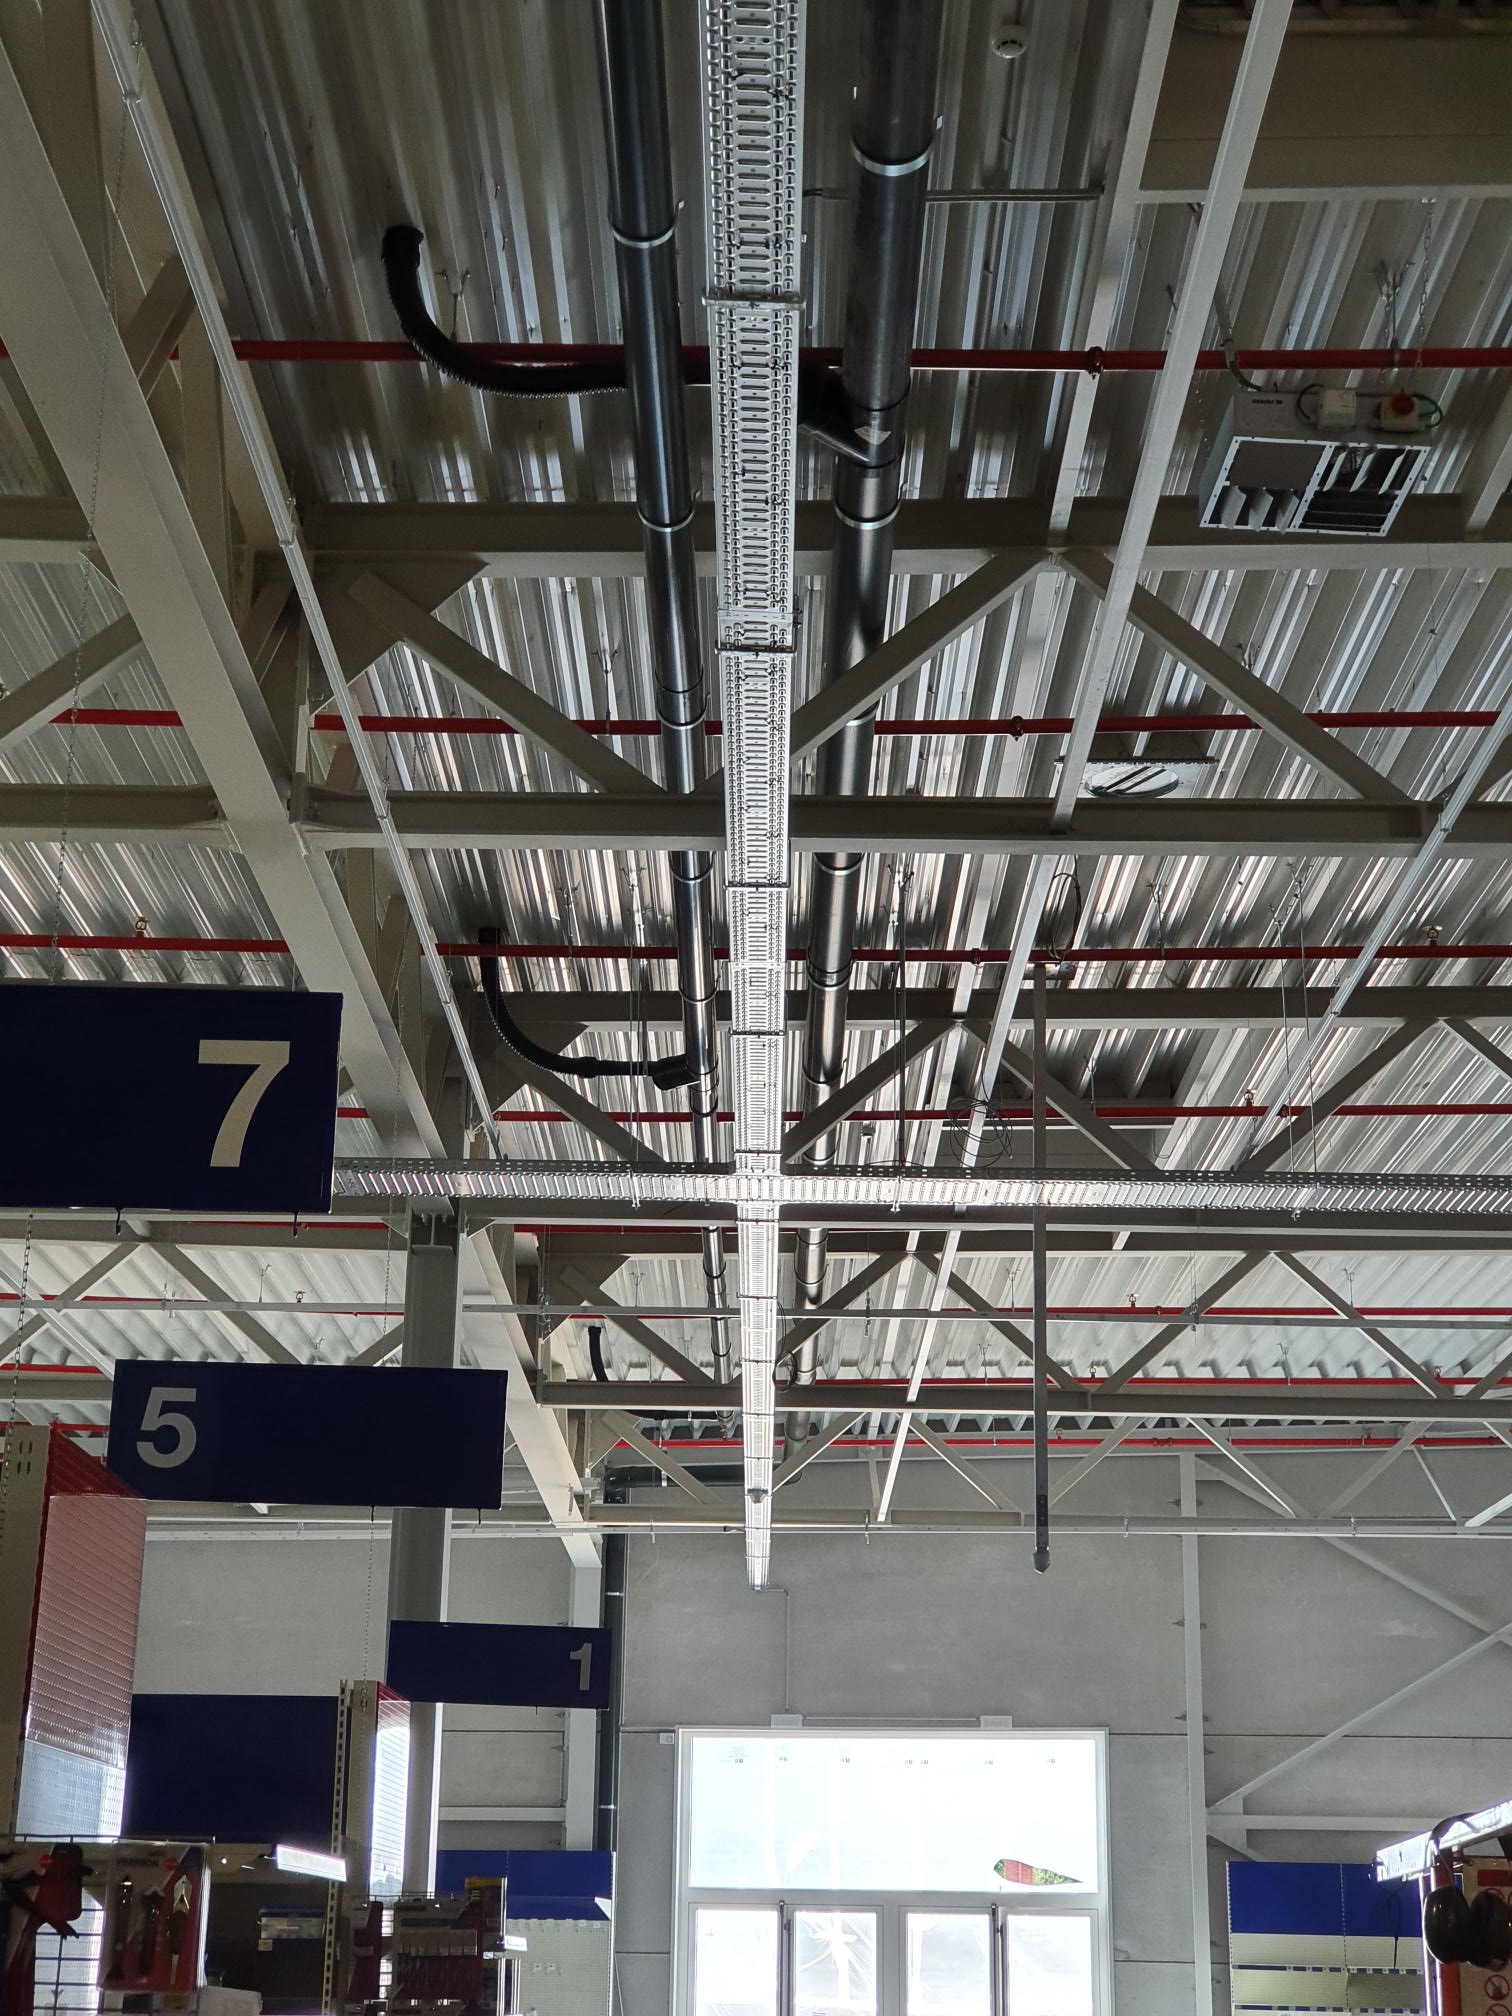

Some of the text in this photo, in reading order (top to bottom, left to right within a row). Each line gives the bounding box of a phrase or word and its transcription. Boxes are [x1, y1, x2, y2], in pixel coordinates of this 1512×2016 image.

[199, 1040, 290, 1167] 7
[137, 1387, 197, 1468] 5
[569, 1642, 592, 1691] 1
